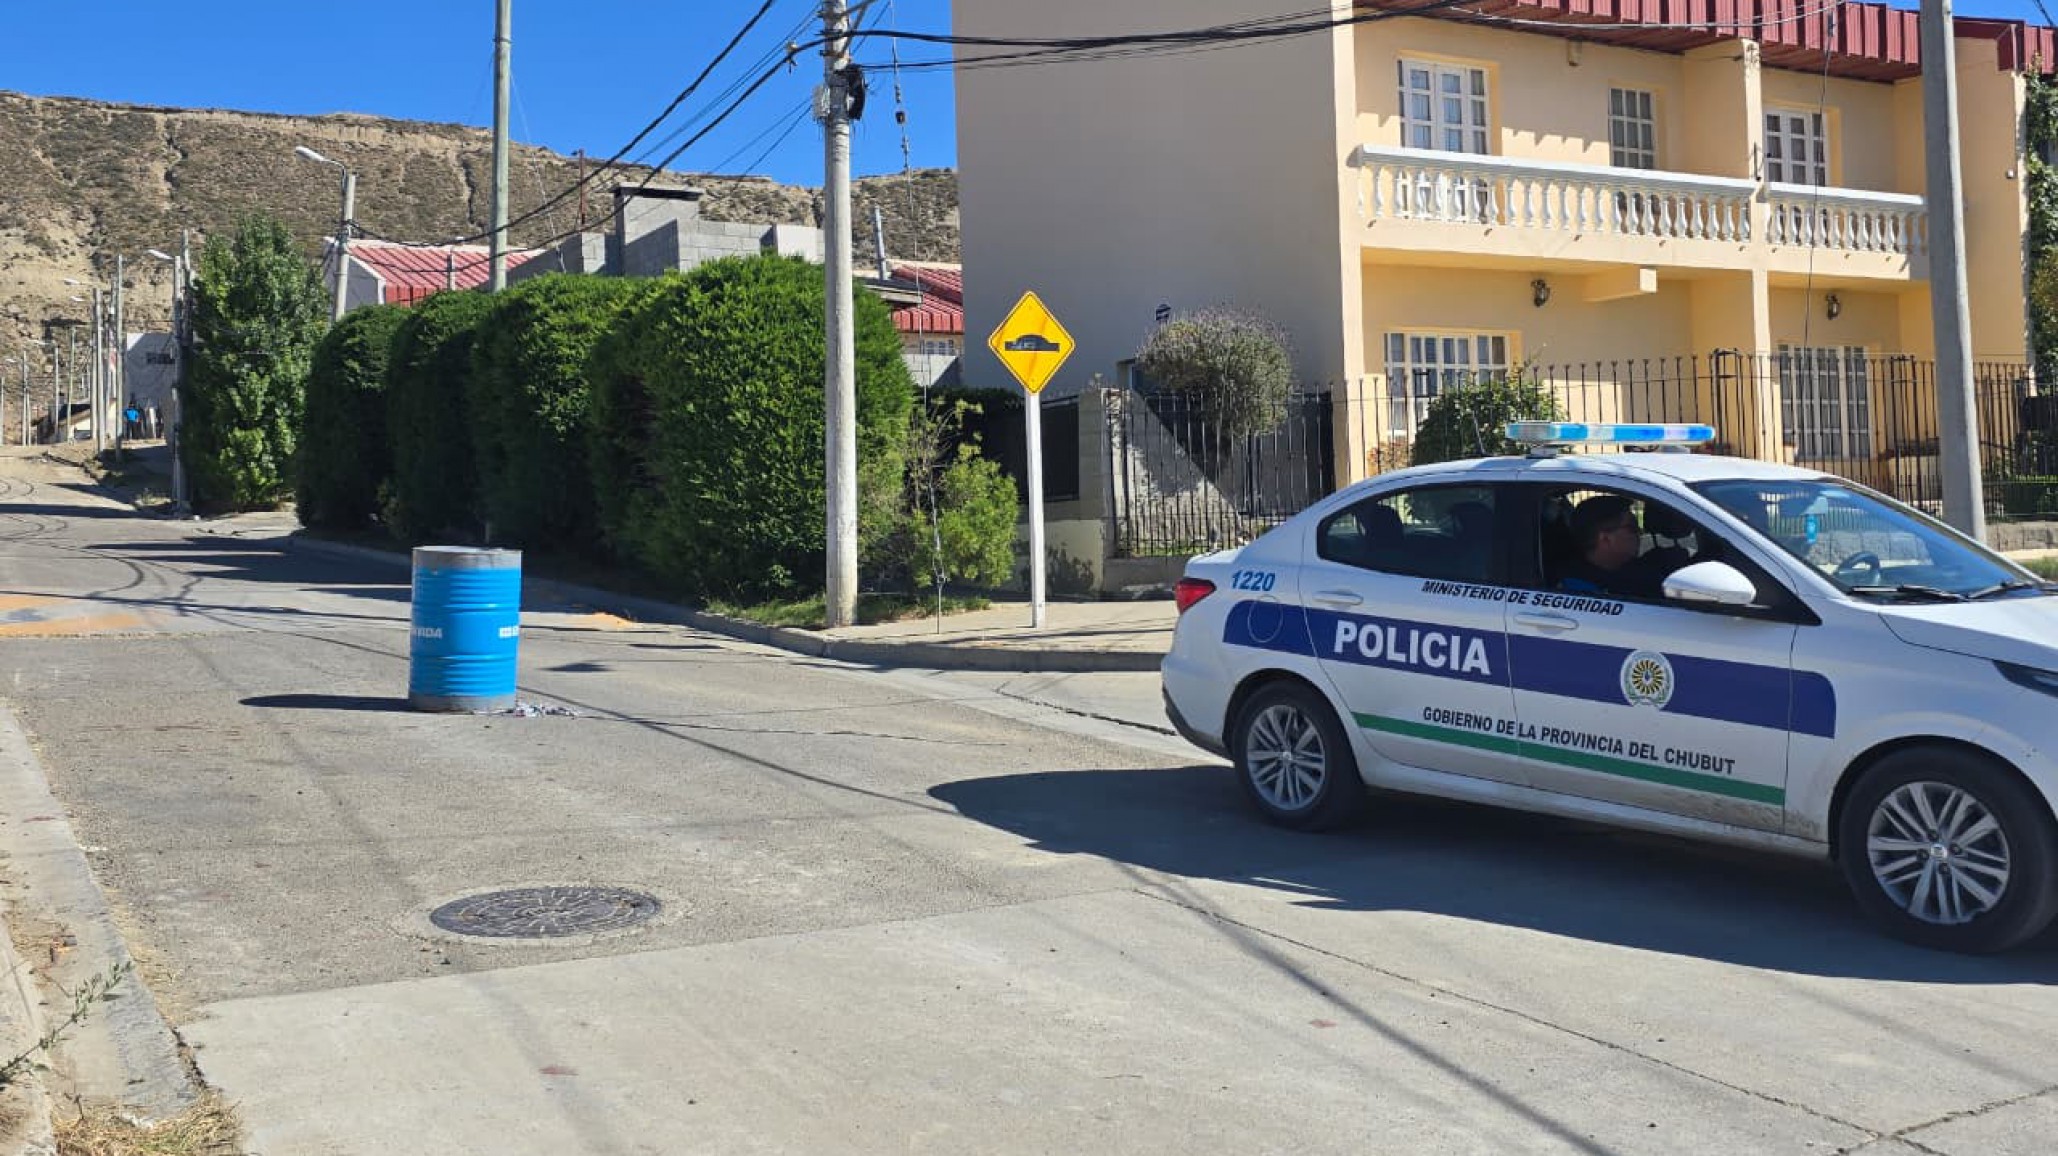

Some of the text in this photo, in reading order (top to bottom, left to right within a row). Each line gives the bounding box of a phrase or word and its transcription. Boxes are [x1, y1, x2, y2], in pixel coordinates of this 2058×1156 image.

[1231, 570, 1276, 592] 1220
[1421, 580, 1625, 616] MINISTERIO DE SEGURIDAD
[1333, 619, 1491, 676] POLICIA
[1423, 706, 1735, 775] GOBIERNO DE LA PROVINCIA DEL CHUBUT
